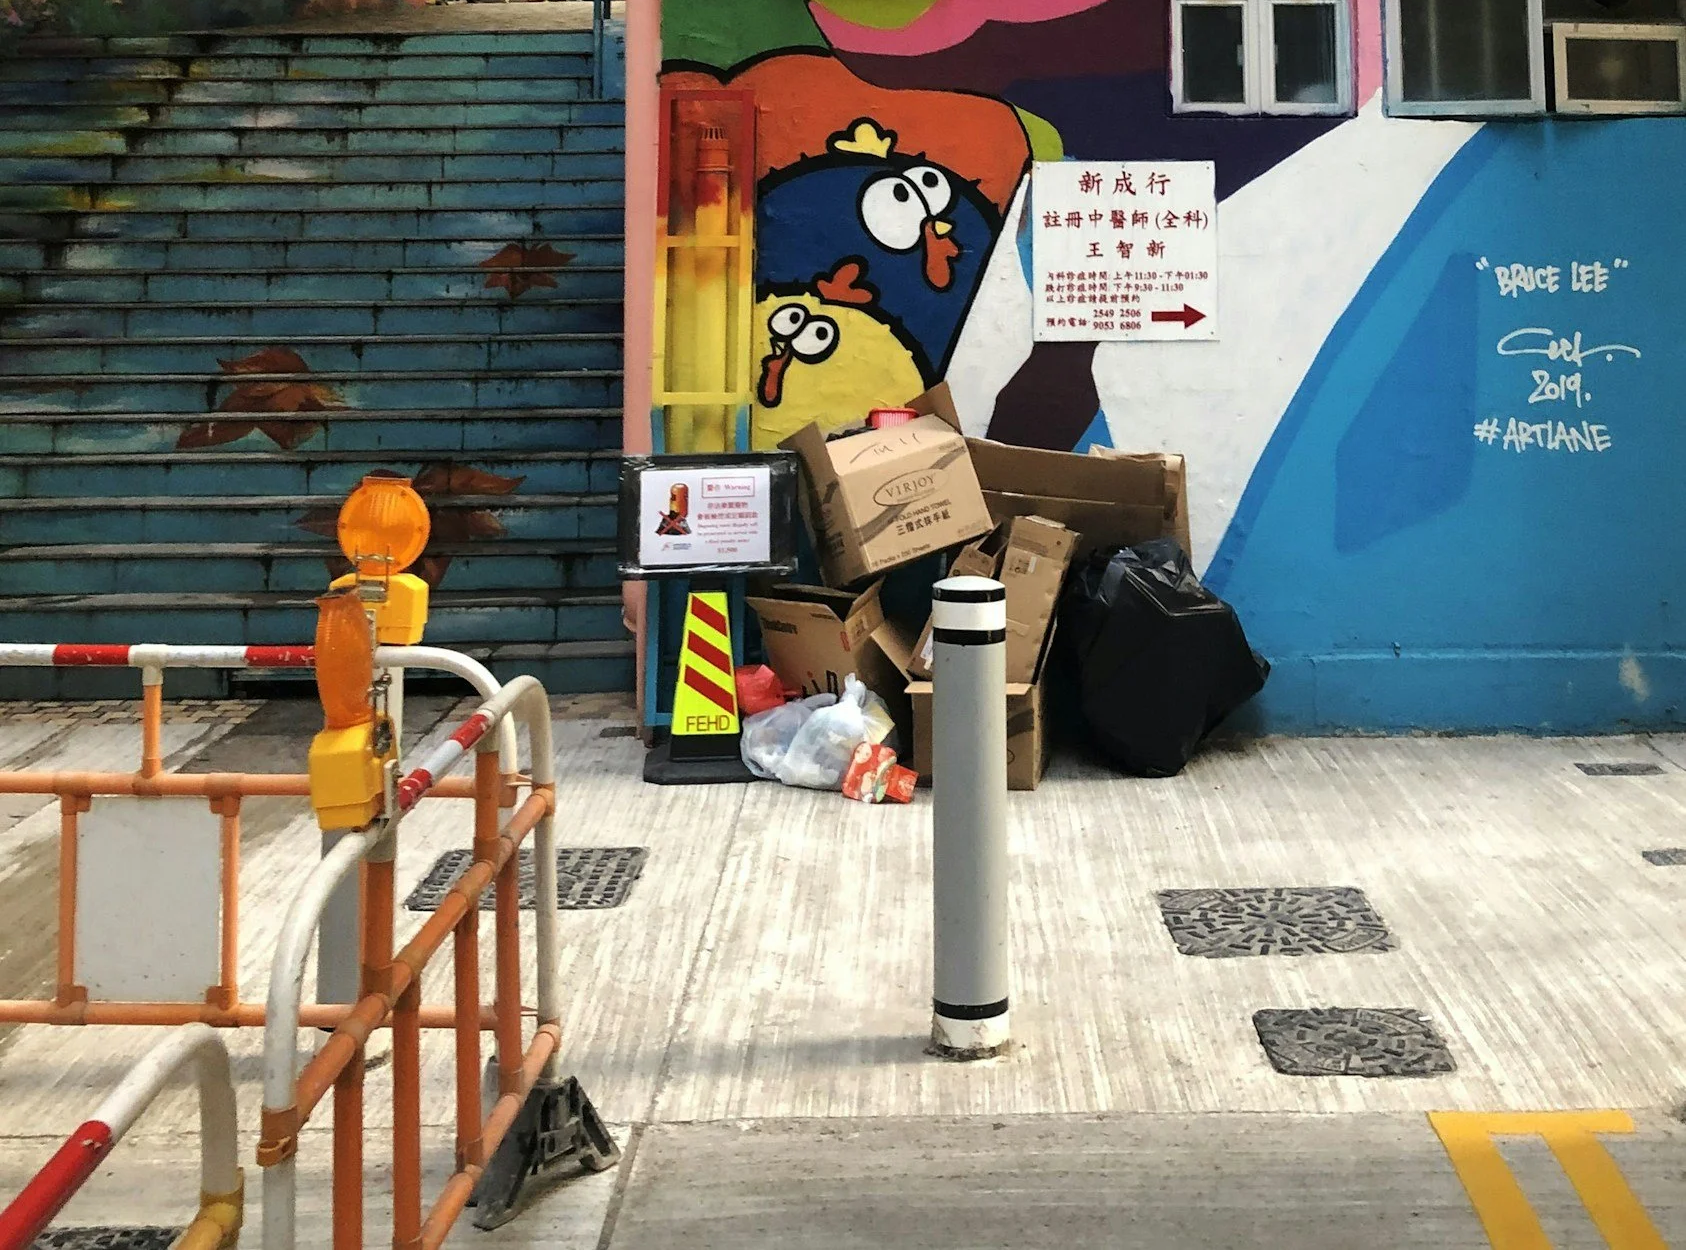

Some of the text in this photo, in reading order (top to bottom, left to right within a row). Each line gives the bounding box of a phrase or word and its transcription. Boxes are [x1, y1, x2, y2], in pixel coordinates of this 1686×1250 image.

[1078, 171, 1171, 196] 新成行
[1043, 209, 1209, 230] 註冊中醫師(全科)
[1086, 239, 1166, 259] 王智新
[1093, 309, 1141, 318] 2549 2506
[1093, 321, 1141, 330] 9053 6806
[1473, 416, 1612, 453] #ARTLANE
[885, 473, 936, 498] VIRJOY
[686, 714, 731, 732] FEHD
